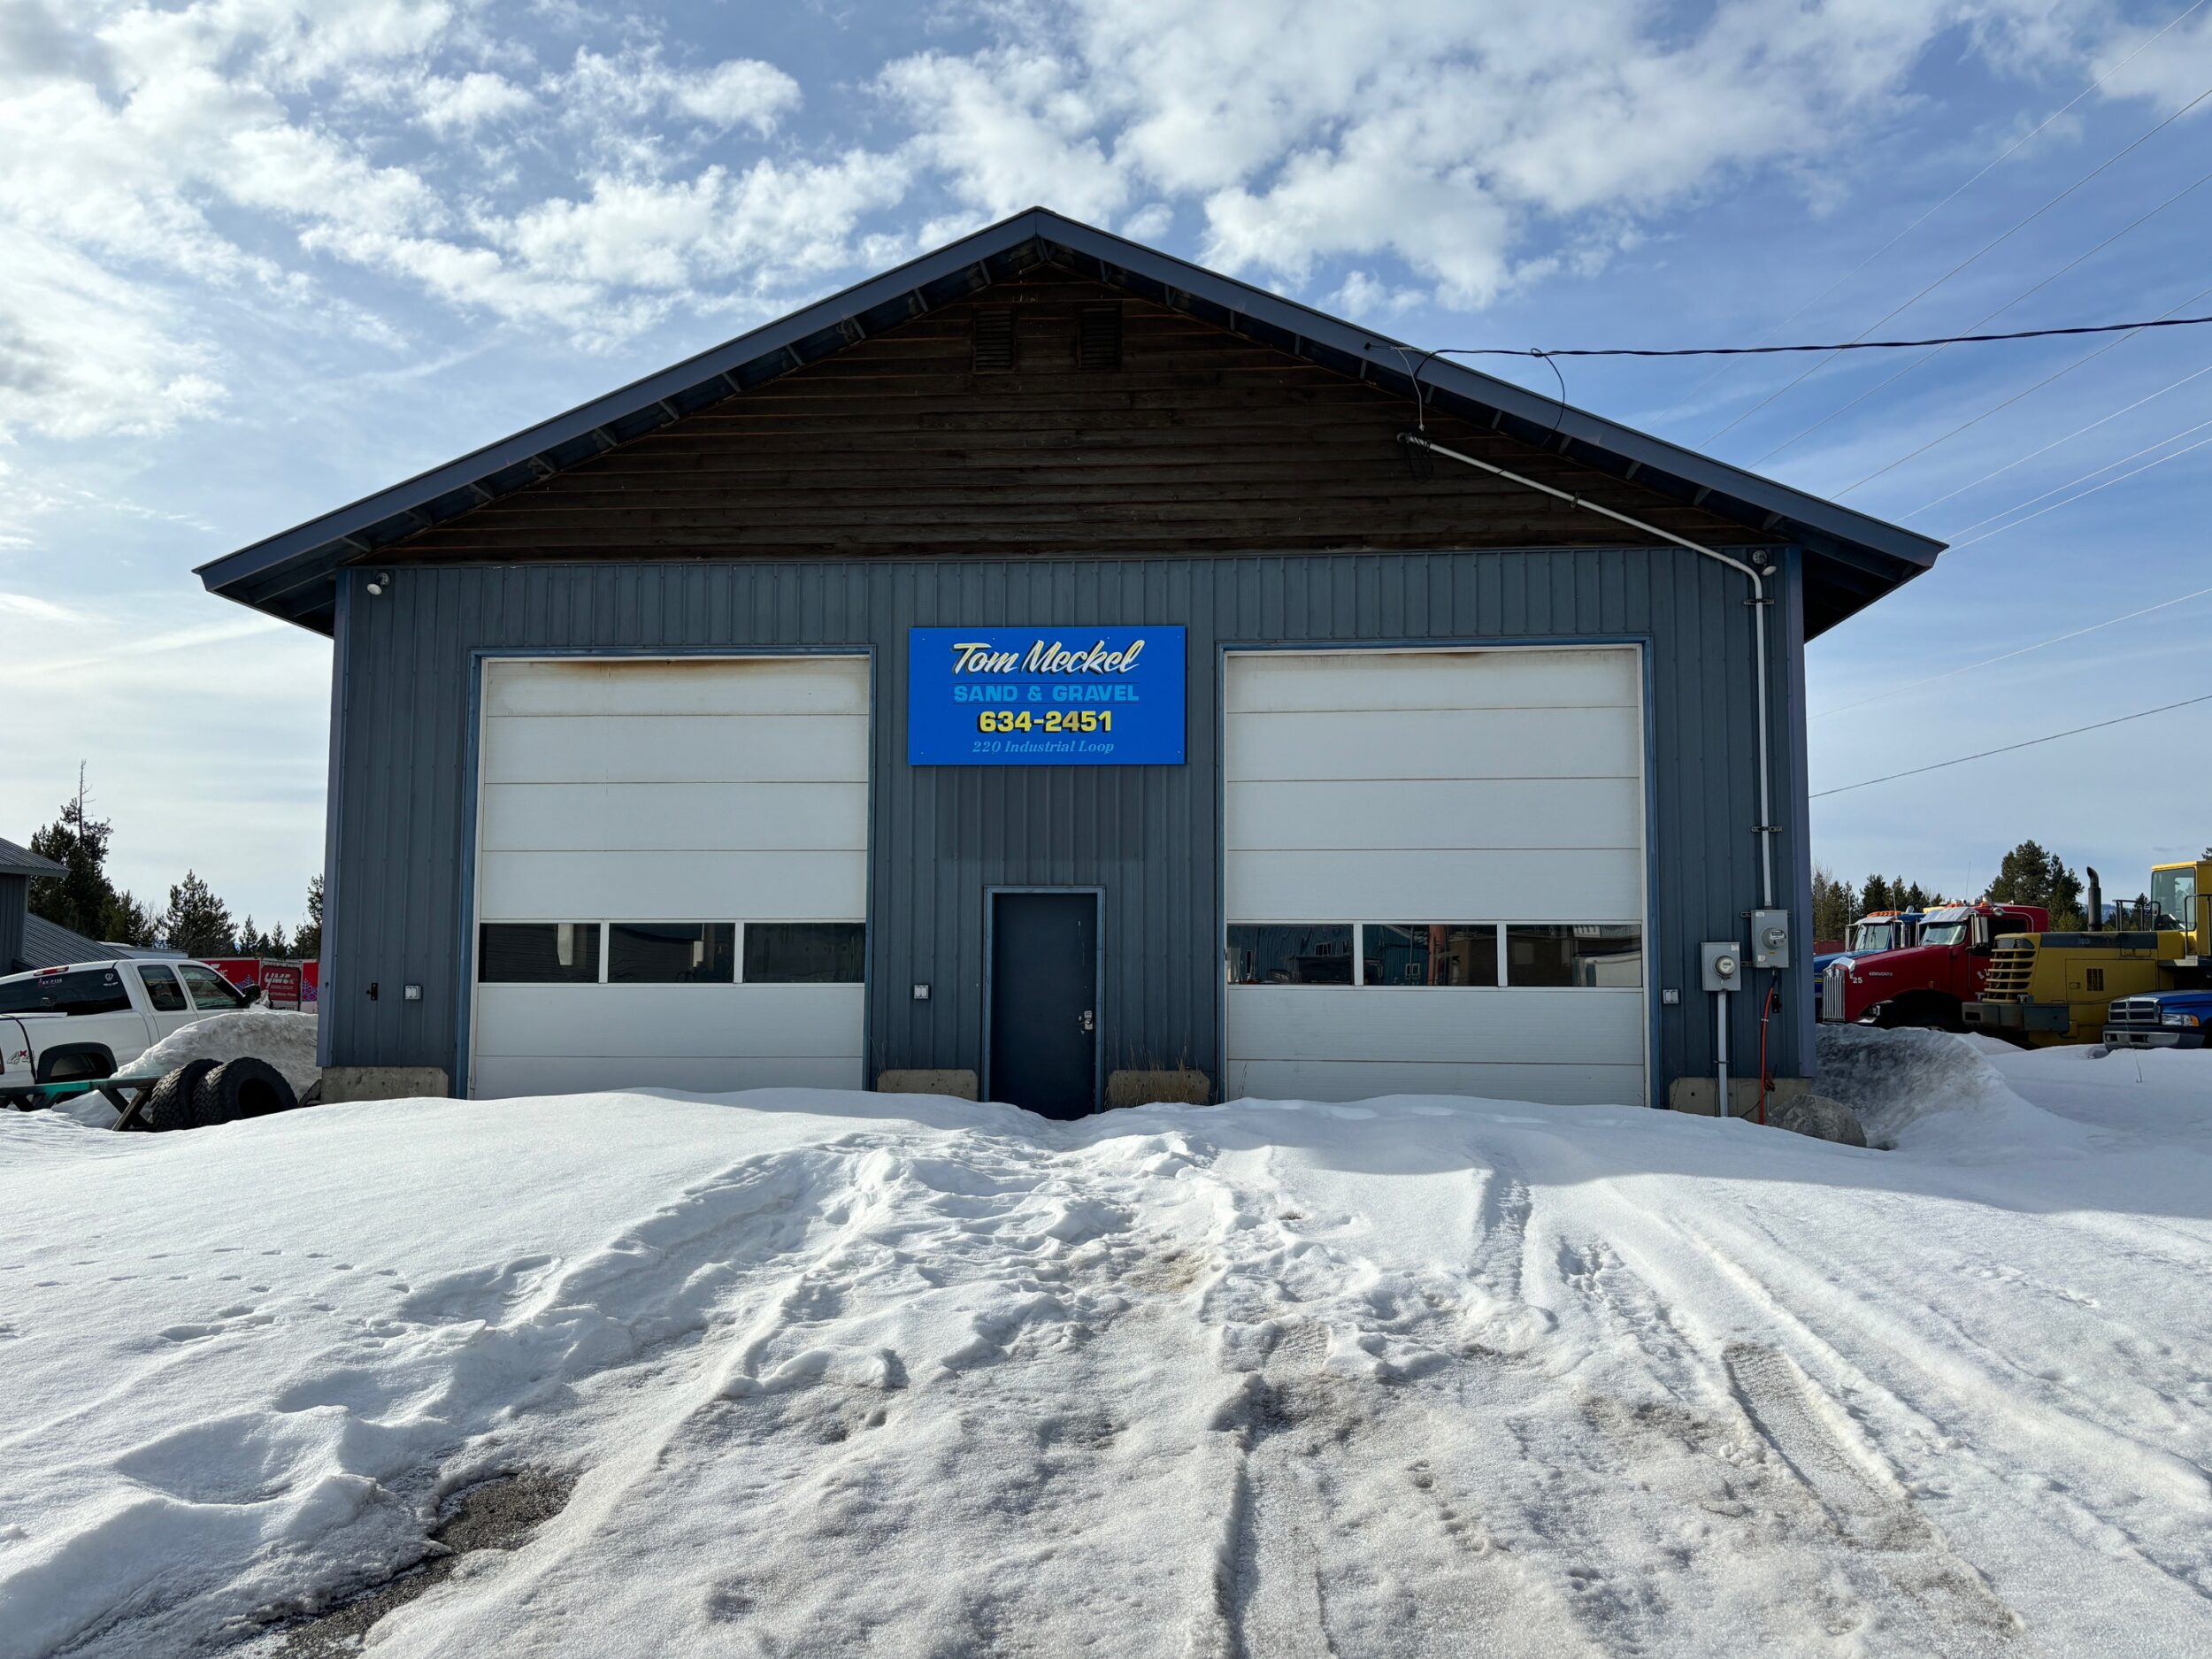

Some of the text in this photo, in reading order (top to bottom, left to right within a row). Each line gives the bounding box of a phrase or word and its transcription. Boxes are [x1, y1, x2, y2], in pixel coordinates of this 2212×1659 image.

[952, 639, 1145, 674] Tom Meckel
[954, 685, 1140, 702] SAND & GRAVEL
[979, 710, 1111, 733] 634-2451
[973, 741, 1114, 754] 220 Industrial Loop
